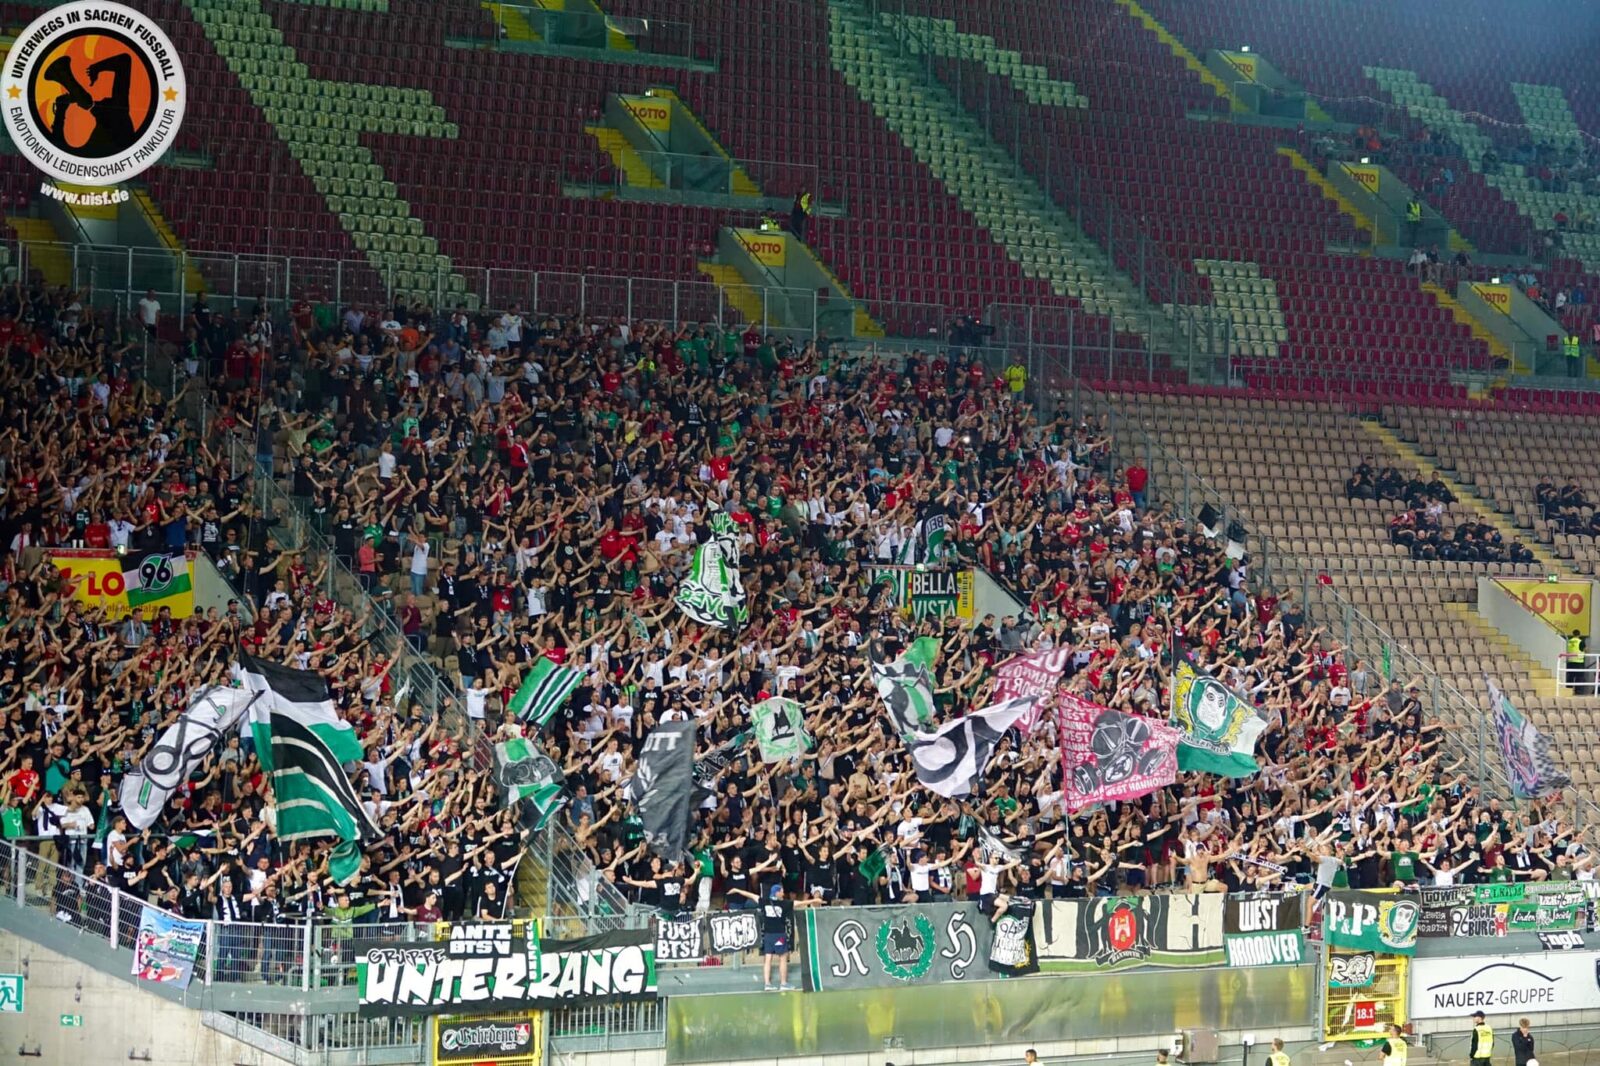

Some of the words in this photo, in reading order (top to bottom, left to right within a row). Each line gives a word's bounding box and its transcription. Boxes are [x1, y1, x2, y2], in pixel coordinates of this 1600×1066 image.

[141, 556, 172, 588] 96
[912, 573, 956, 595] BELLA
[911, 600, 956, 625] VISTA
[1521, 591, 1584, 615] LOTTO
[1238, 900, 1280, 932] WEST
[450, 924, 512, 940] ANTI
[658, 920, 700, 940] FUCK
[366, 948, 446, 968] GRUPPE
[449, 940, 511, 955] BTSV
[657, 940, 700, 958] BTSV
[1227, 933, 1301, 967] HANNOVER
[364, 944, 649, 1003] UNTERRANG
[1434, 987, 1555, 1009] NAUERZ-GRUPPE
[1356, 1008, 1375, 1020] 18.1
